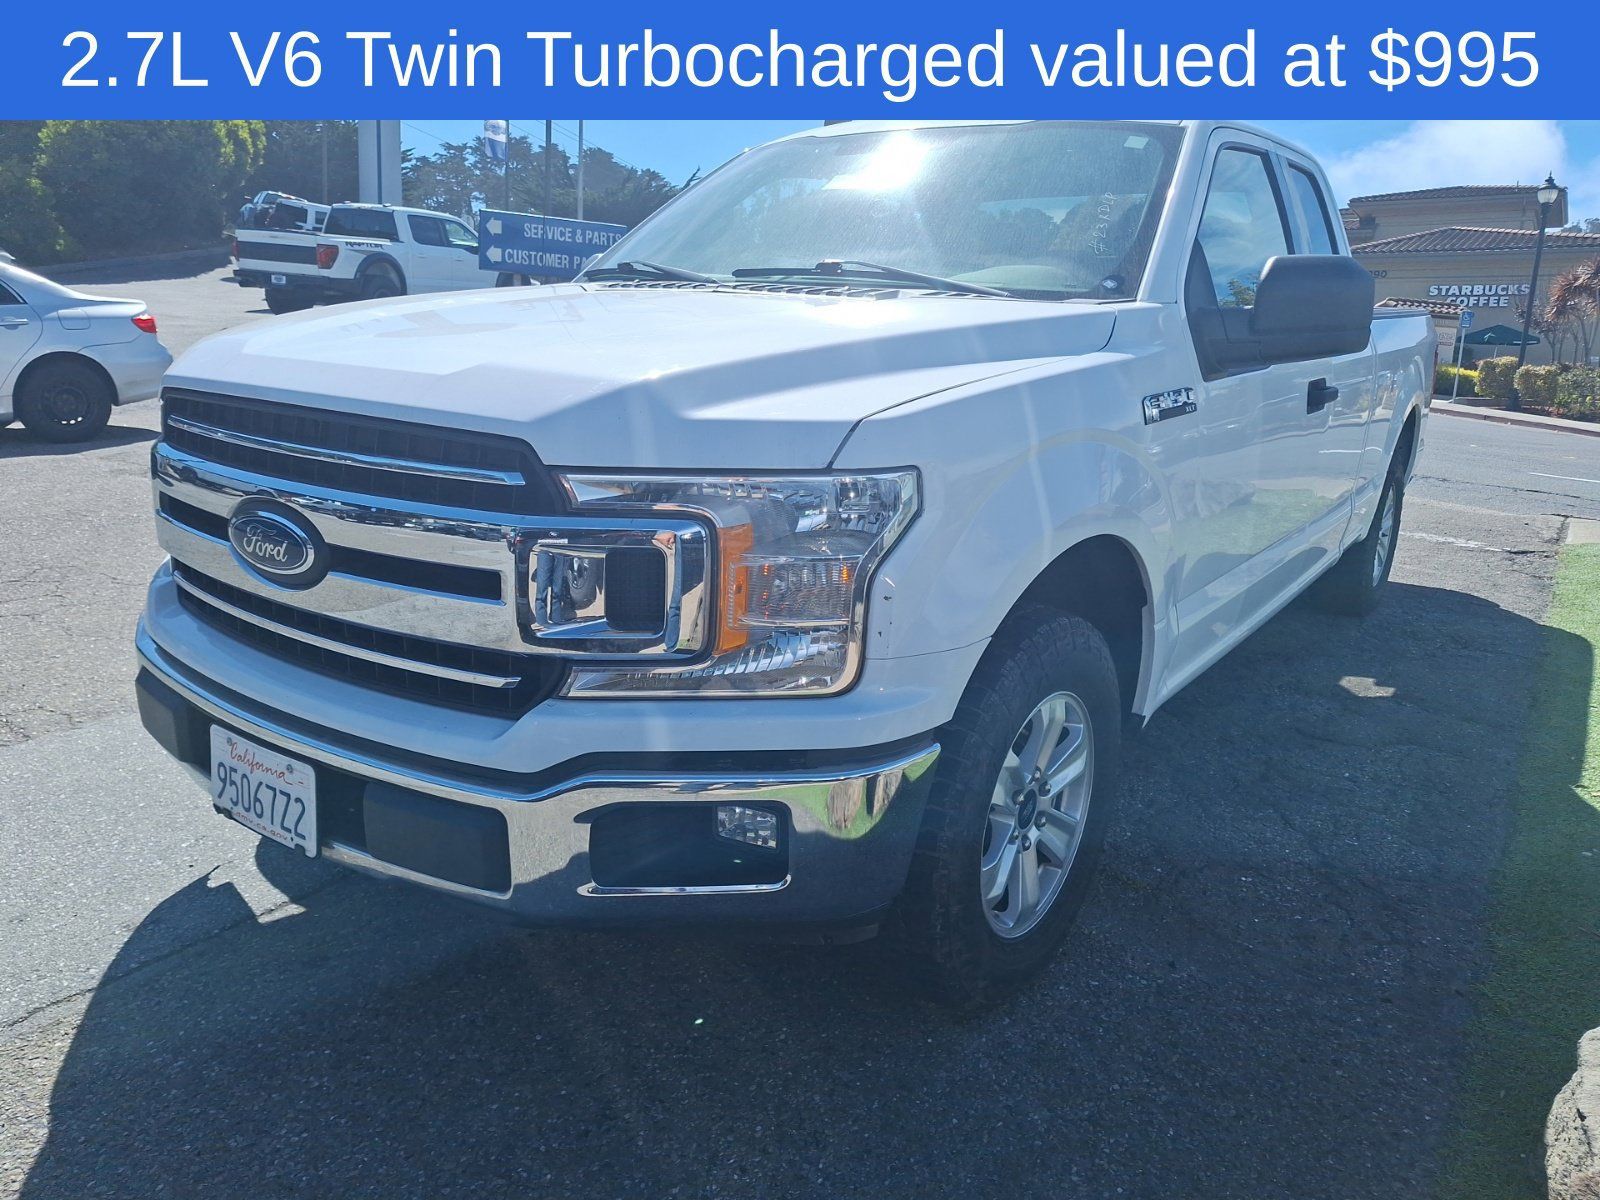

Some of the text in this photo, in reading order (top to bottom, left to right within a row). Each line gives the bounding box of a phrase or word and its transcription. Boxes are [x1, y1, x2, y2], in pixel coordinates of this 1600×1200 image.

[524, 223, 573, 242] SERVICE
[575, 229, 584, 244] &
[504, 248, 569, 269] CUSTOMER
[1429, 283, 1531, 296] STARBUCKS
[243, 523, 289, 562] Ford
[230, 742, 293, 785] California
